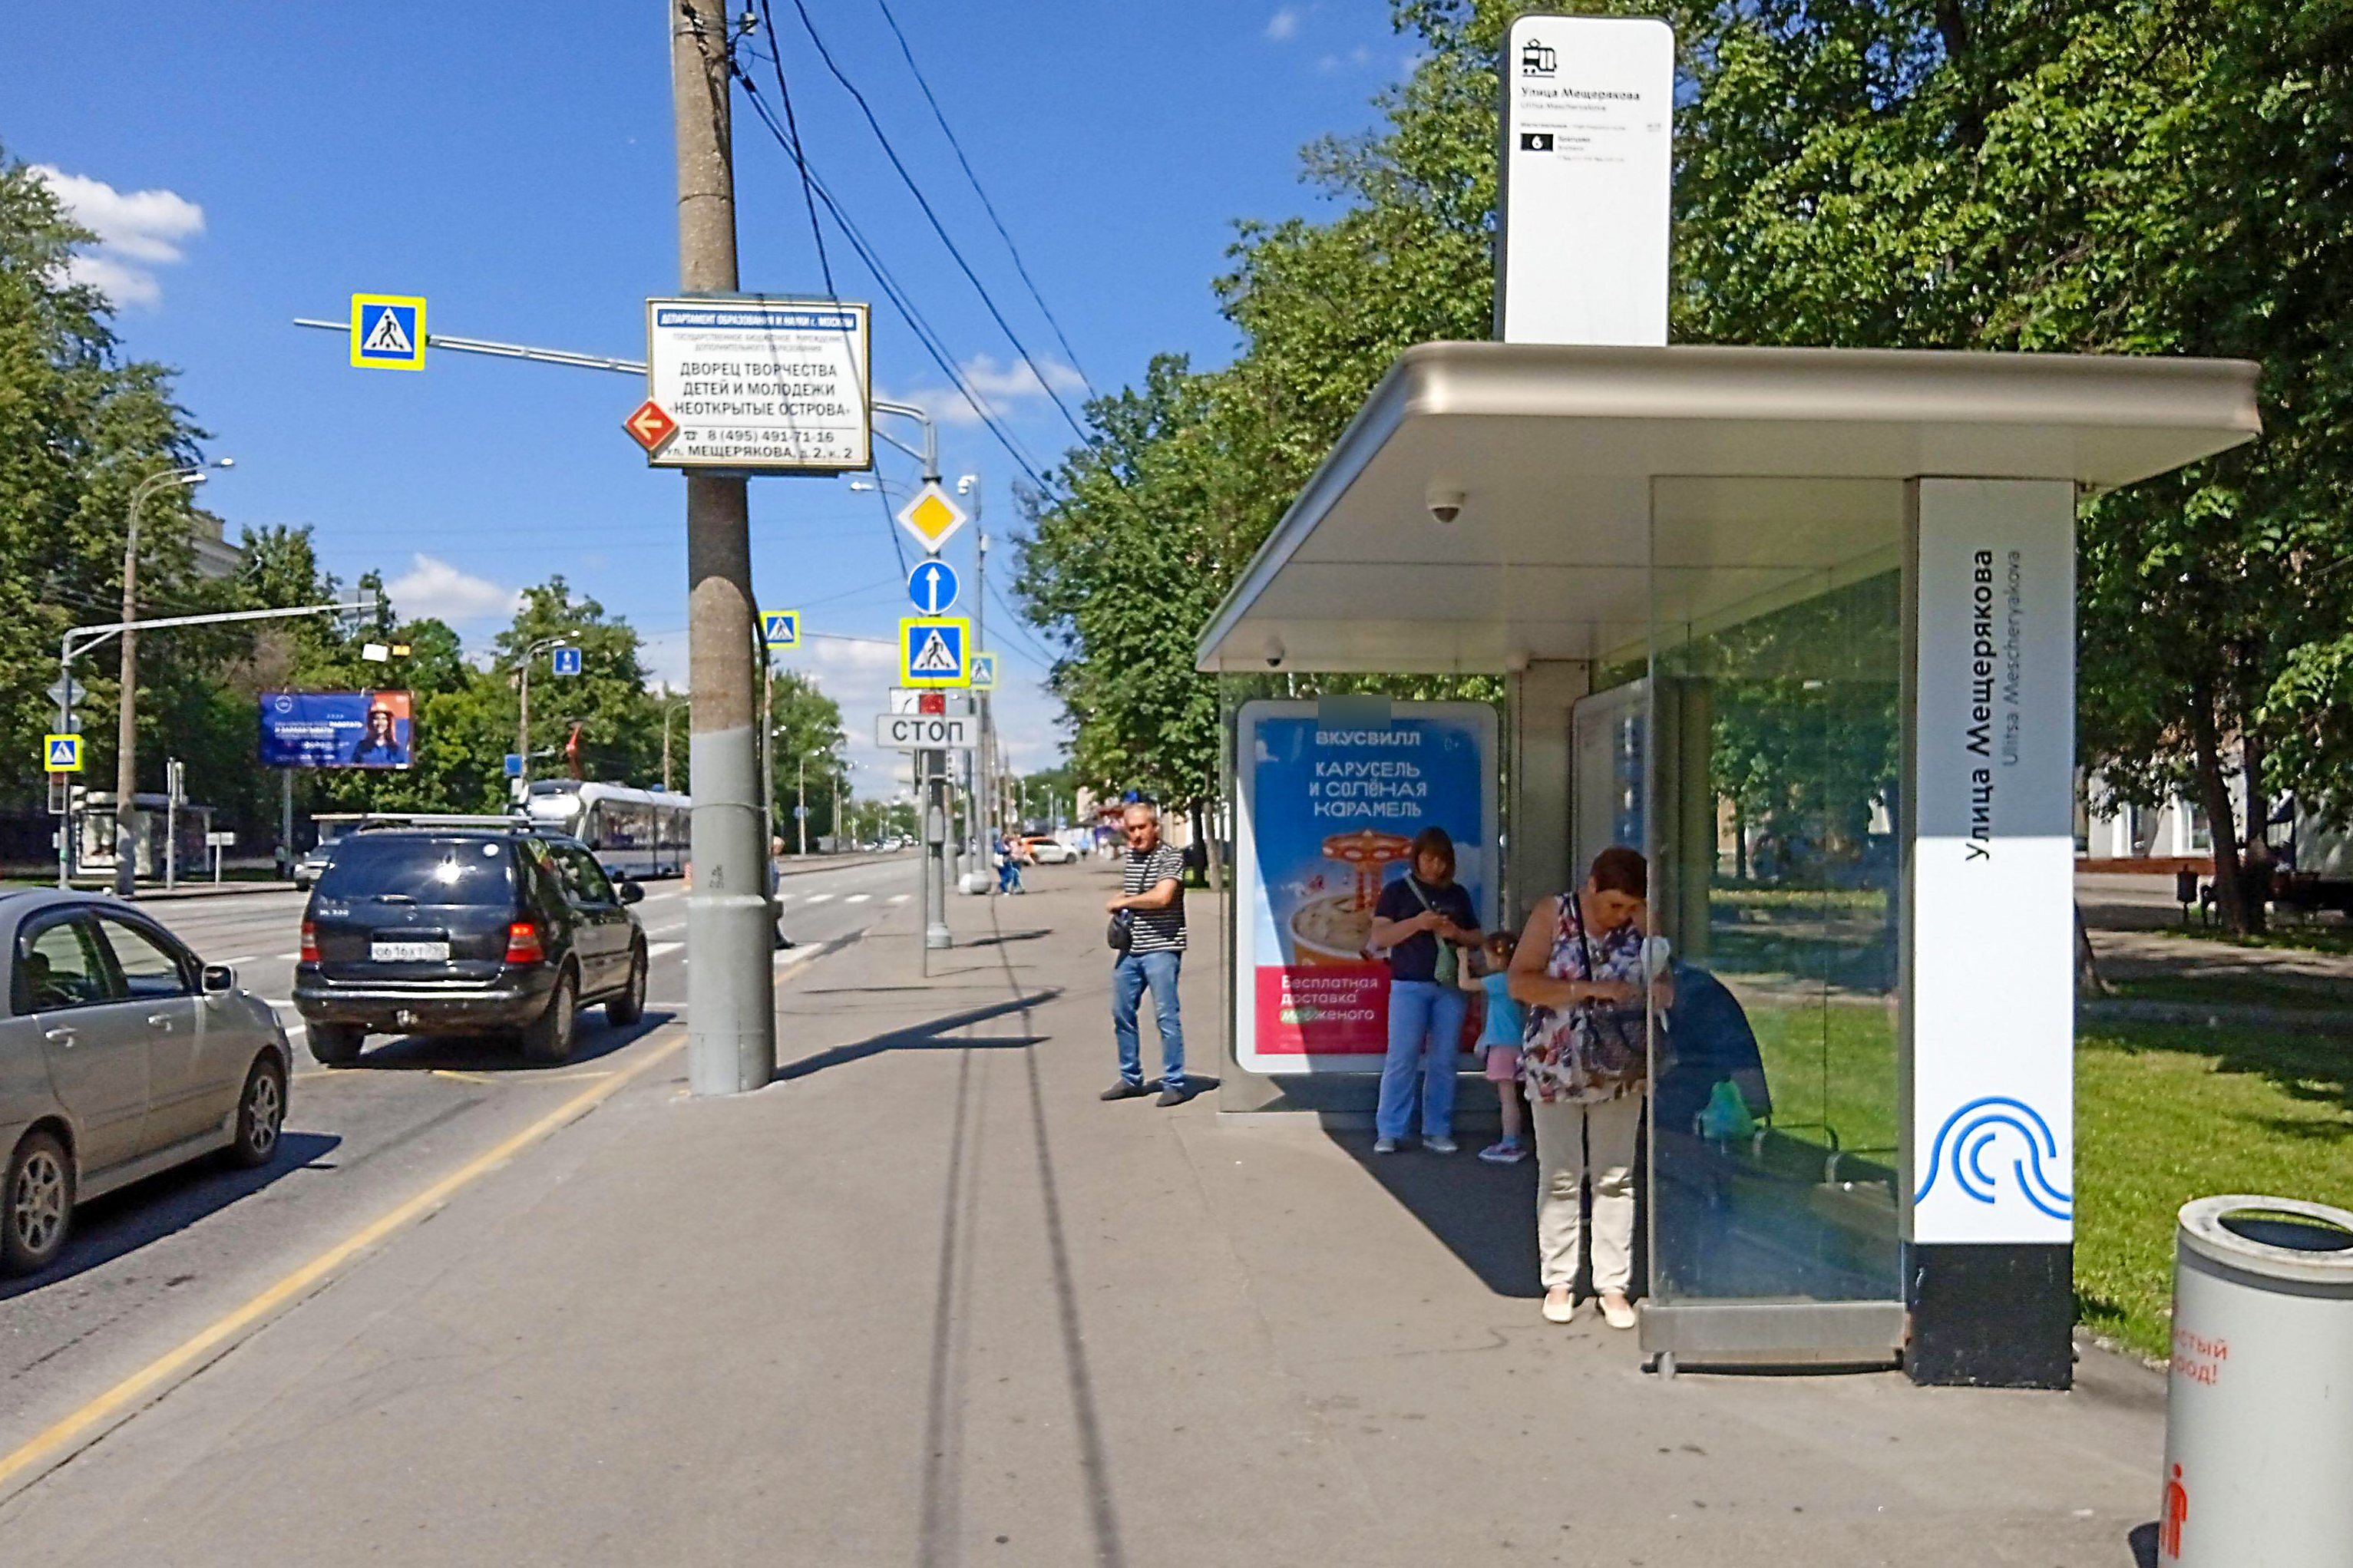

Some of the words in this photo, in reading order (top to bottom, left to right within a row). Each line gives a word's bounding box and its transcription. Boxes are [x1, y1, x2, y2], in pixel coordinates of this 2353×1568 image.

[1532, 135, 1543, 150] 6
[680, 362, 741, 377] ДВОРЕЦ
[745, 363, 838, 377] ТВОРЧЕСТВА
[682, 379, 729, 396] ДЕТЕЙ
[733, 383, 743, 394] И
[748, 383, 834, 397] МОЛОДЕЖИ
[708, 431, 717, 441] 8
[720, 430, 758, 443] (495)
[762, 431, 834, 443] 491-71-16
[844, 447, 853, 459] 2
[2002, 550, 2024, 705] Mescheryakova
[1966, 549, 1998, 756] Мещерякова
[892, 721, 963, 741] СТОП
[1315, 731, 1421, 745] ВКУСВИЛЛ
[2002, 713, 2019, 766] Ulitsa
[1315, 761, 1421, 777] КАРУСЕЛЬ
[1309, 781, 1320, 797] И
[1965, 767, 1994, 861] Улица
[1281, 975, 1378, 989] Бесплатная
[1281, 1009, 1375, 1022] мженого
